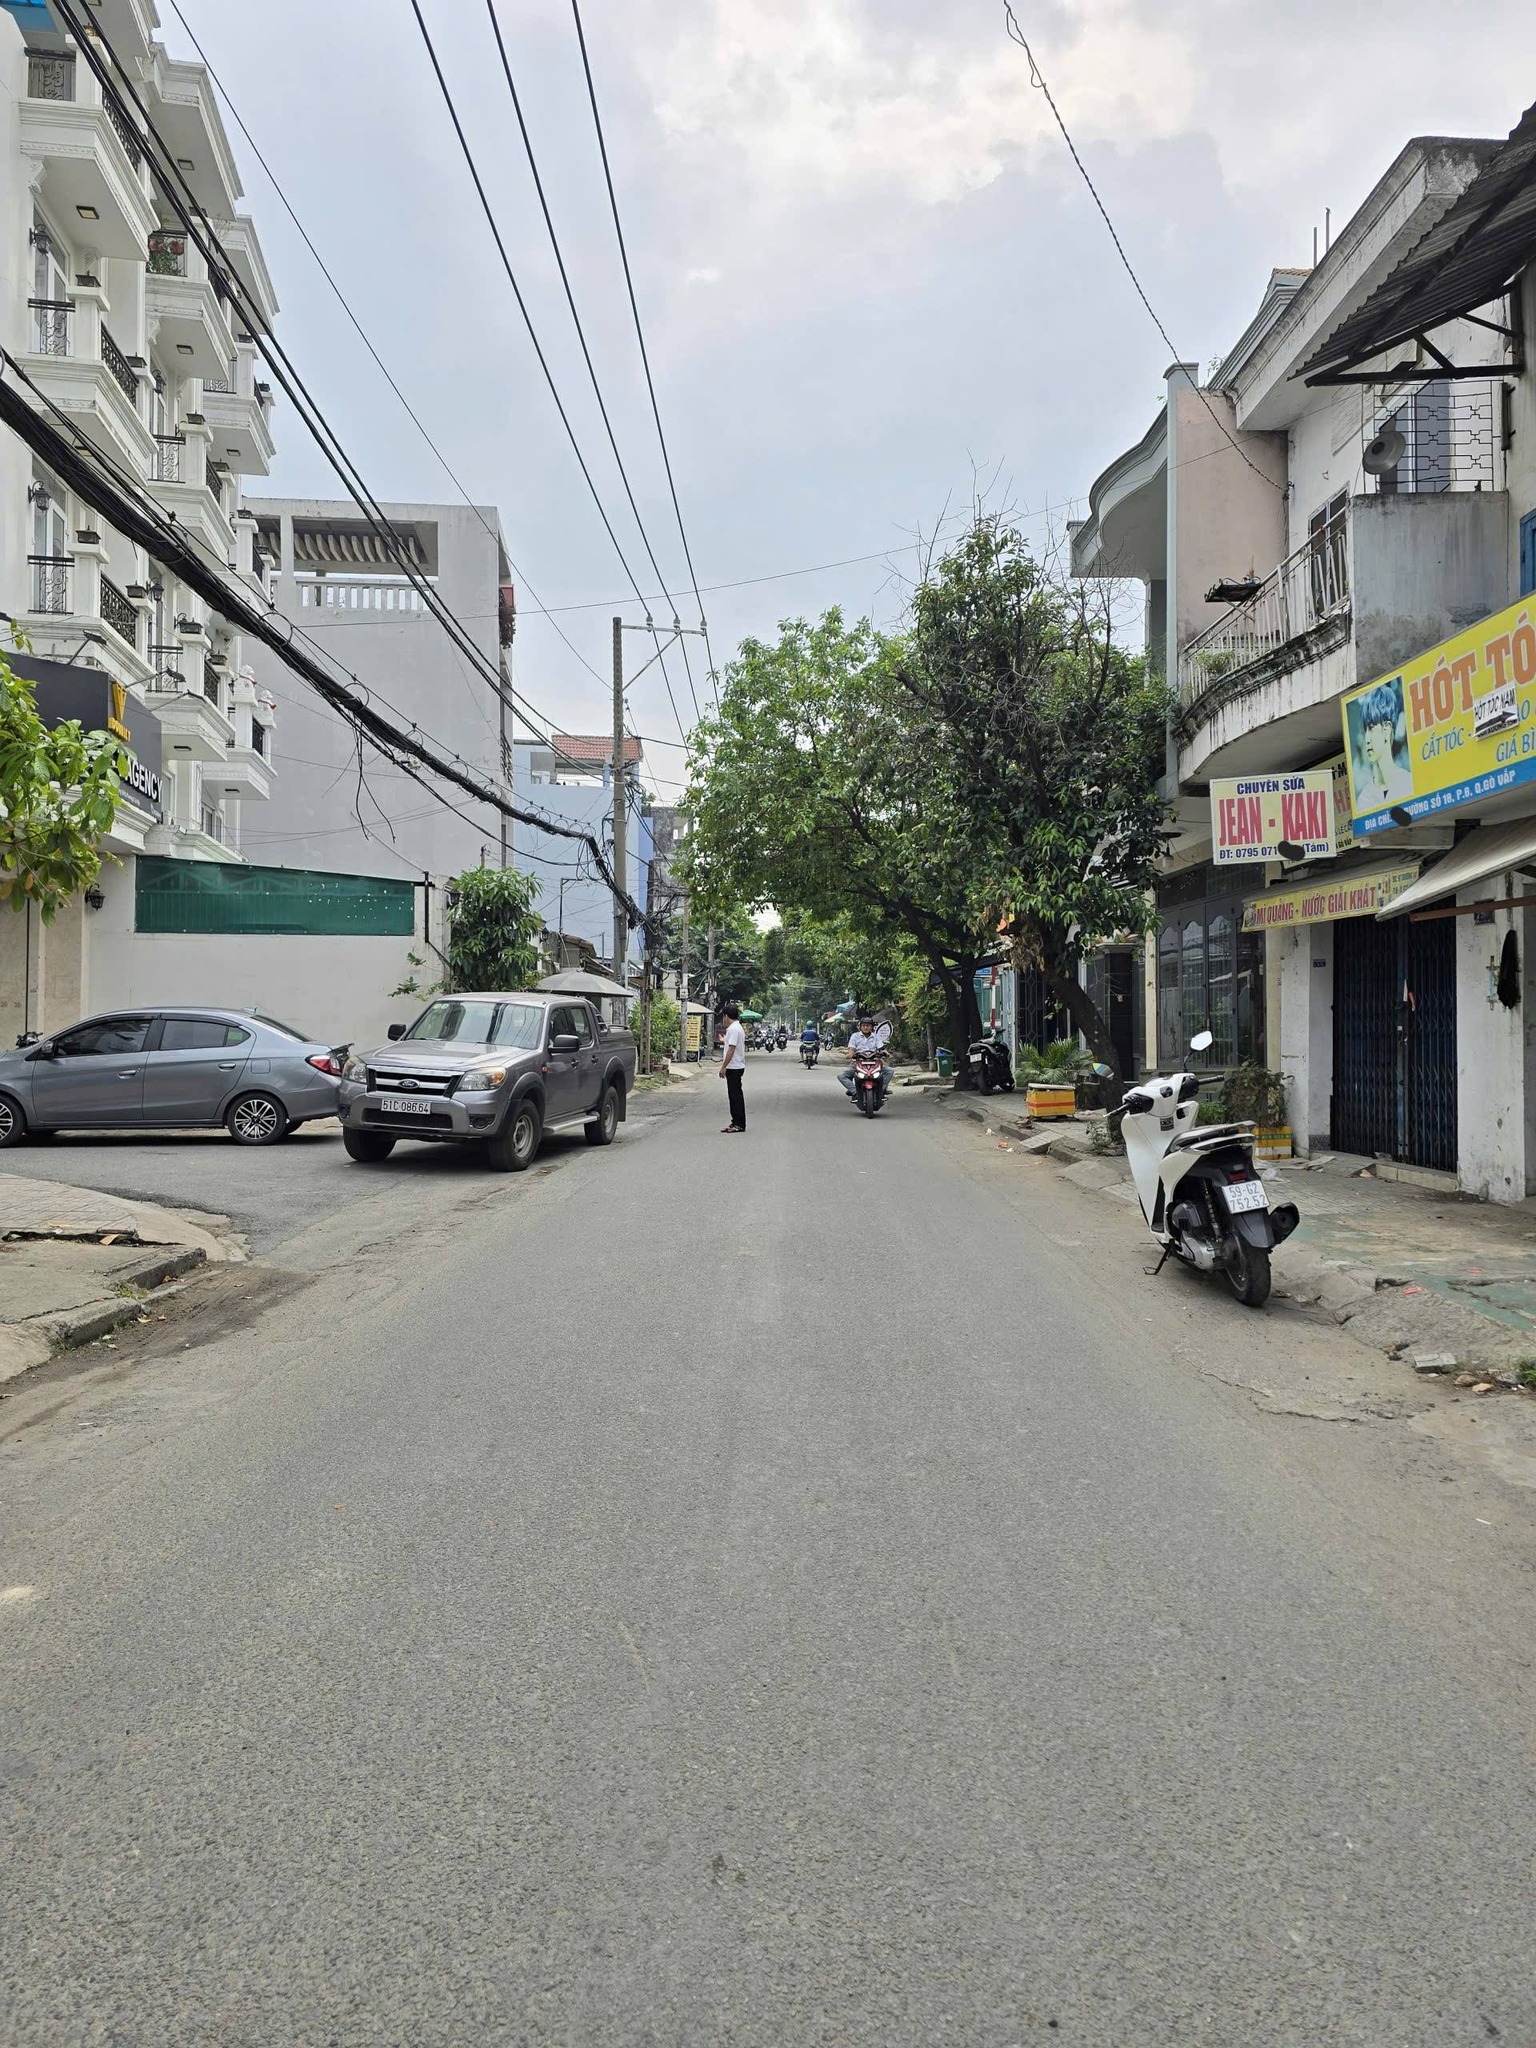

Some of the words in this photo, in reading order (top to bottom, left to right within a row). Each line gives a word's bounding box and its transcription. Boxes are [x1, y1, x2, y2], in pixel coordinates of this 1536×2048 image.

[1444, 726, 1465, 752] TÓC
[1496, 733, 1518, 762] GIÁ
[125, 757, 163, 803] AGENCY
[1237, 780, 1279, 795] CHUYÊN
[1283, 777, 1305, 791] SỬA
[1430, 792, 1441, 809] SỐ
[1219, 796, 1262, 846] JEAN
[1281, 791, 1327, 841] KAKI
[1220, 849, 1233, 859] ĐT:
[1236, 848, 1259, 858] 0795
[1230, 1195, 1268, 1211] 752.52
